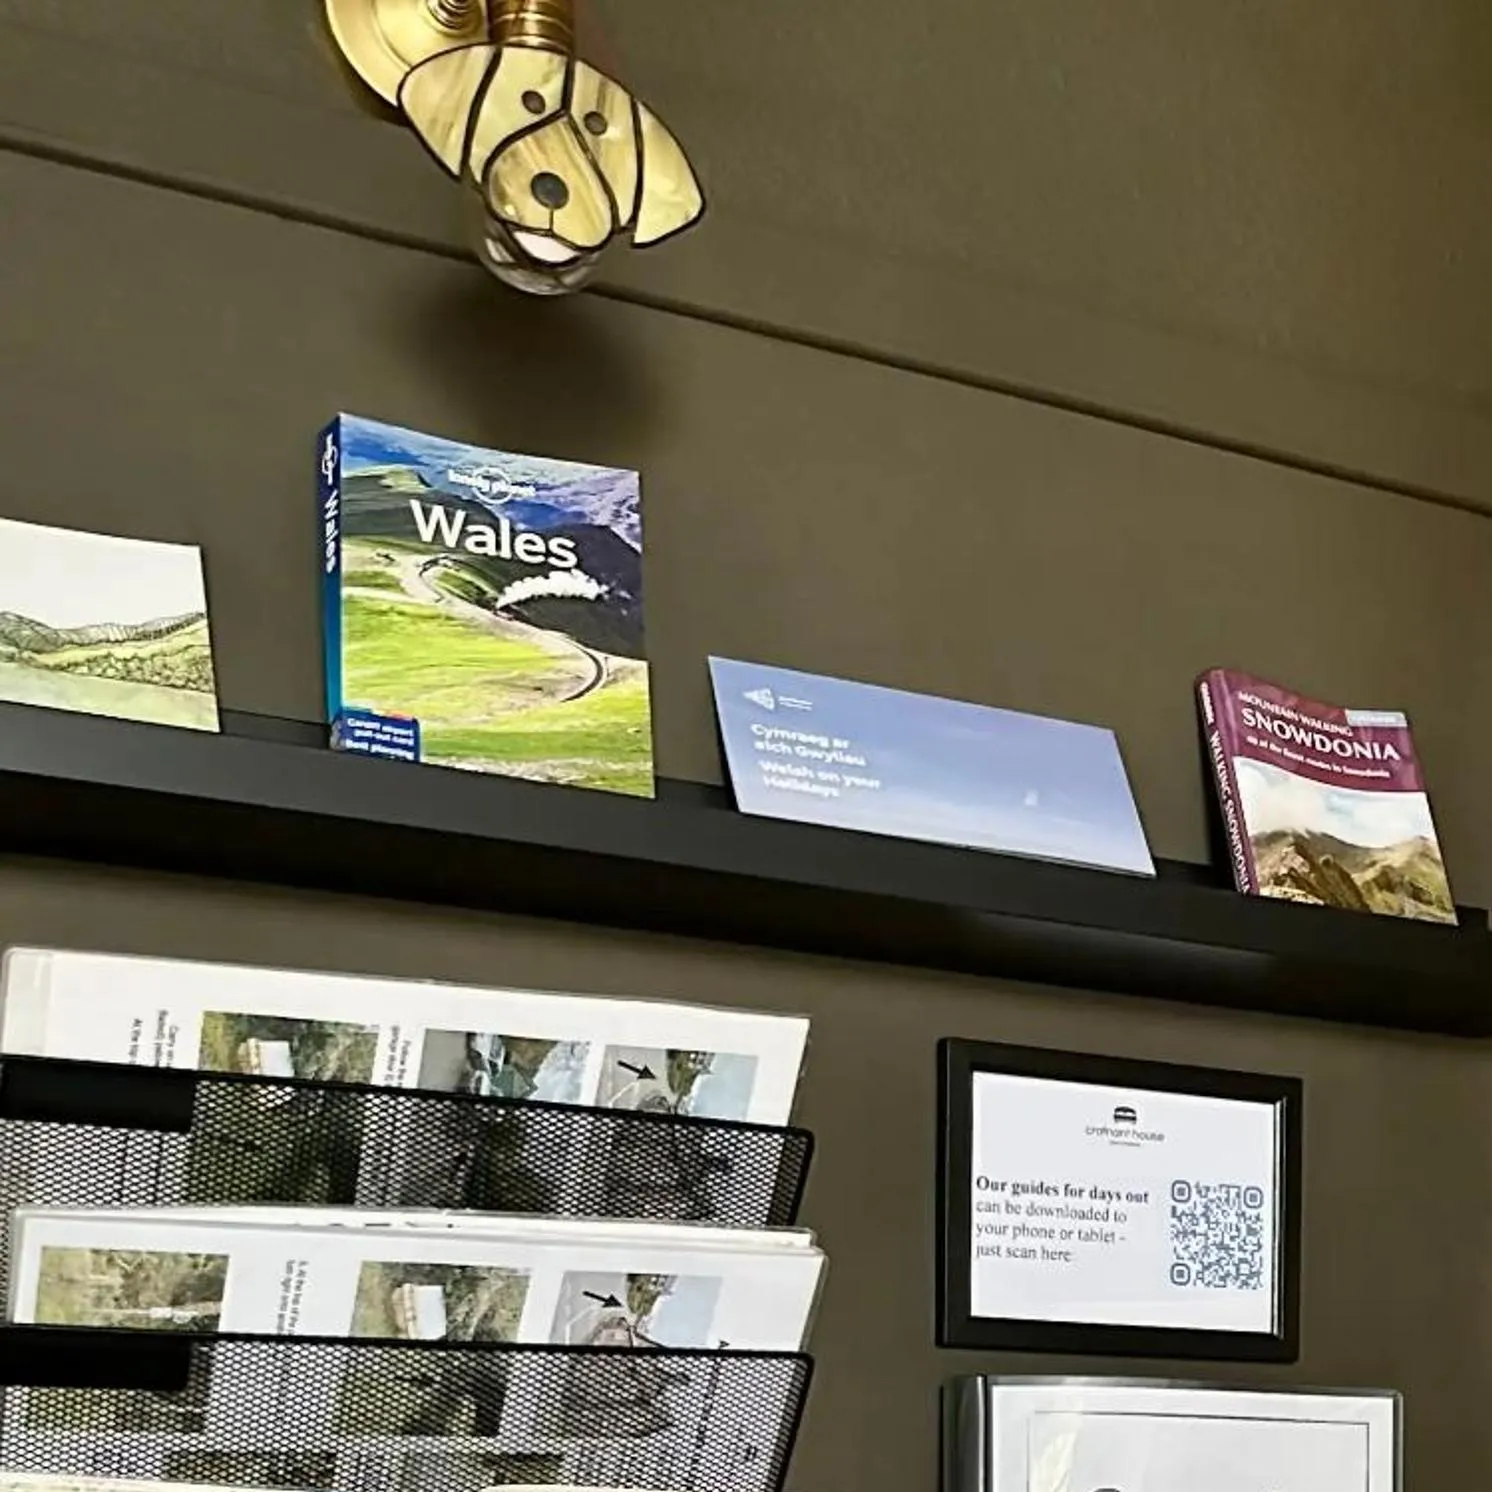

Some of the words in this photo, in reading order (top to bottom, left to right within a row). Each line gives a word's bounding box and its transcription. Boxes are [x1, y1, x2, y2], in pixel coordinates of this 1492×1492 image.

[410, 499, 579, 569] Wales
[1241, 708, 1400, 761] SNOWDONIA
[976, 1176, 1007, 1193] Our
[1011, 1180, 1060, 1198] guides
[1064, 1184, 1086, 1199] for
[1090, 1187, 1122, 1204] days
[1125, 1191, 1150, 1204] out
[1026, 1202, 1110, 1222] downloaded
[1012, 1223, 1055, 1242] phone
